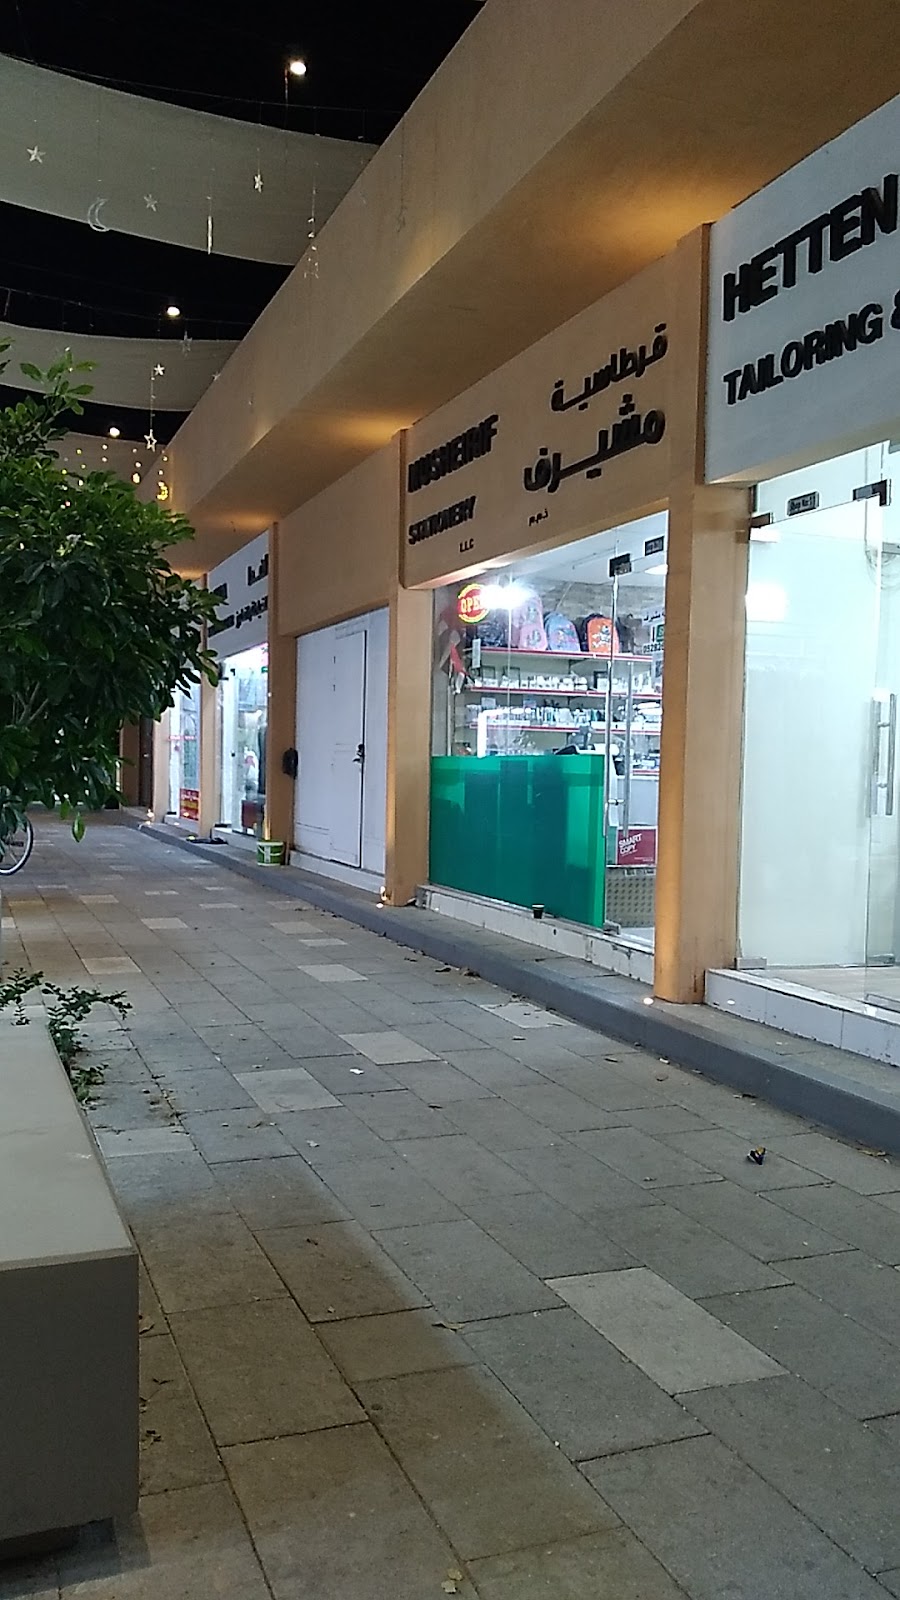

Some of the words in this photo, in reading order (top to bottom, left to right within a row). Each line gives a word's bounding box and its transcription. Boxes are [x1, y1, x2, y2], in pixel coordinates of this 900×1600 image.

[723, 175, 899, 322] HETTEN
[551, 323, 668, 411] قرطاسية
[723, 303, 883, 405] TAILORING
[524, 394, 665, 493] مشيرف
[409, 496, 476, 544] STATIONERY
[460, 539, 474, 552] LLC
[460, 594, 484, 613] OPE
[618, 833, 642, 847] SMART
[619, 843, 637, 855] COPY
